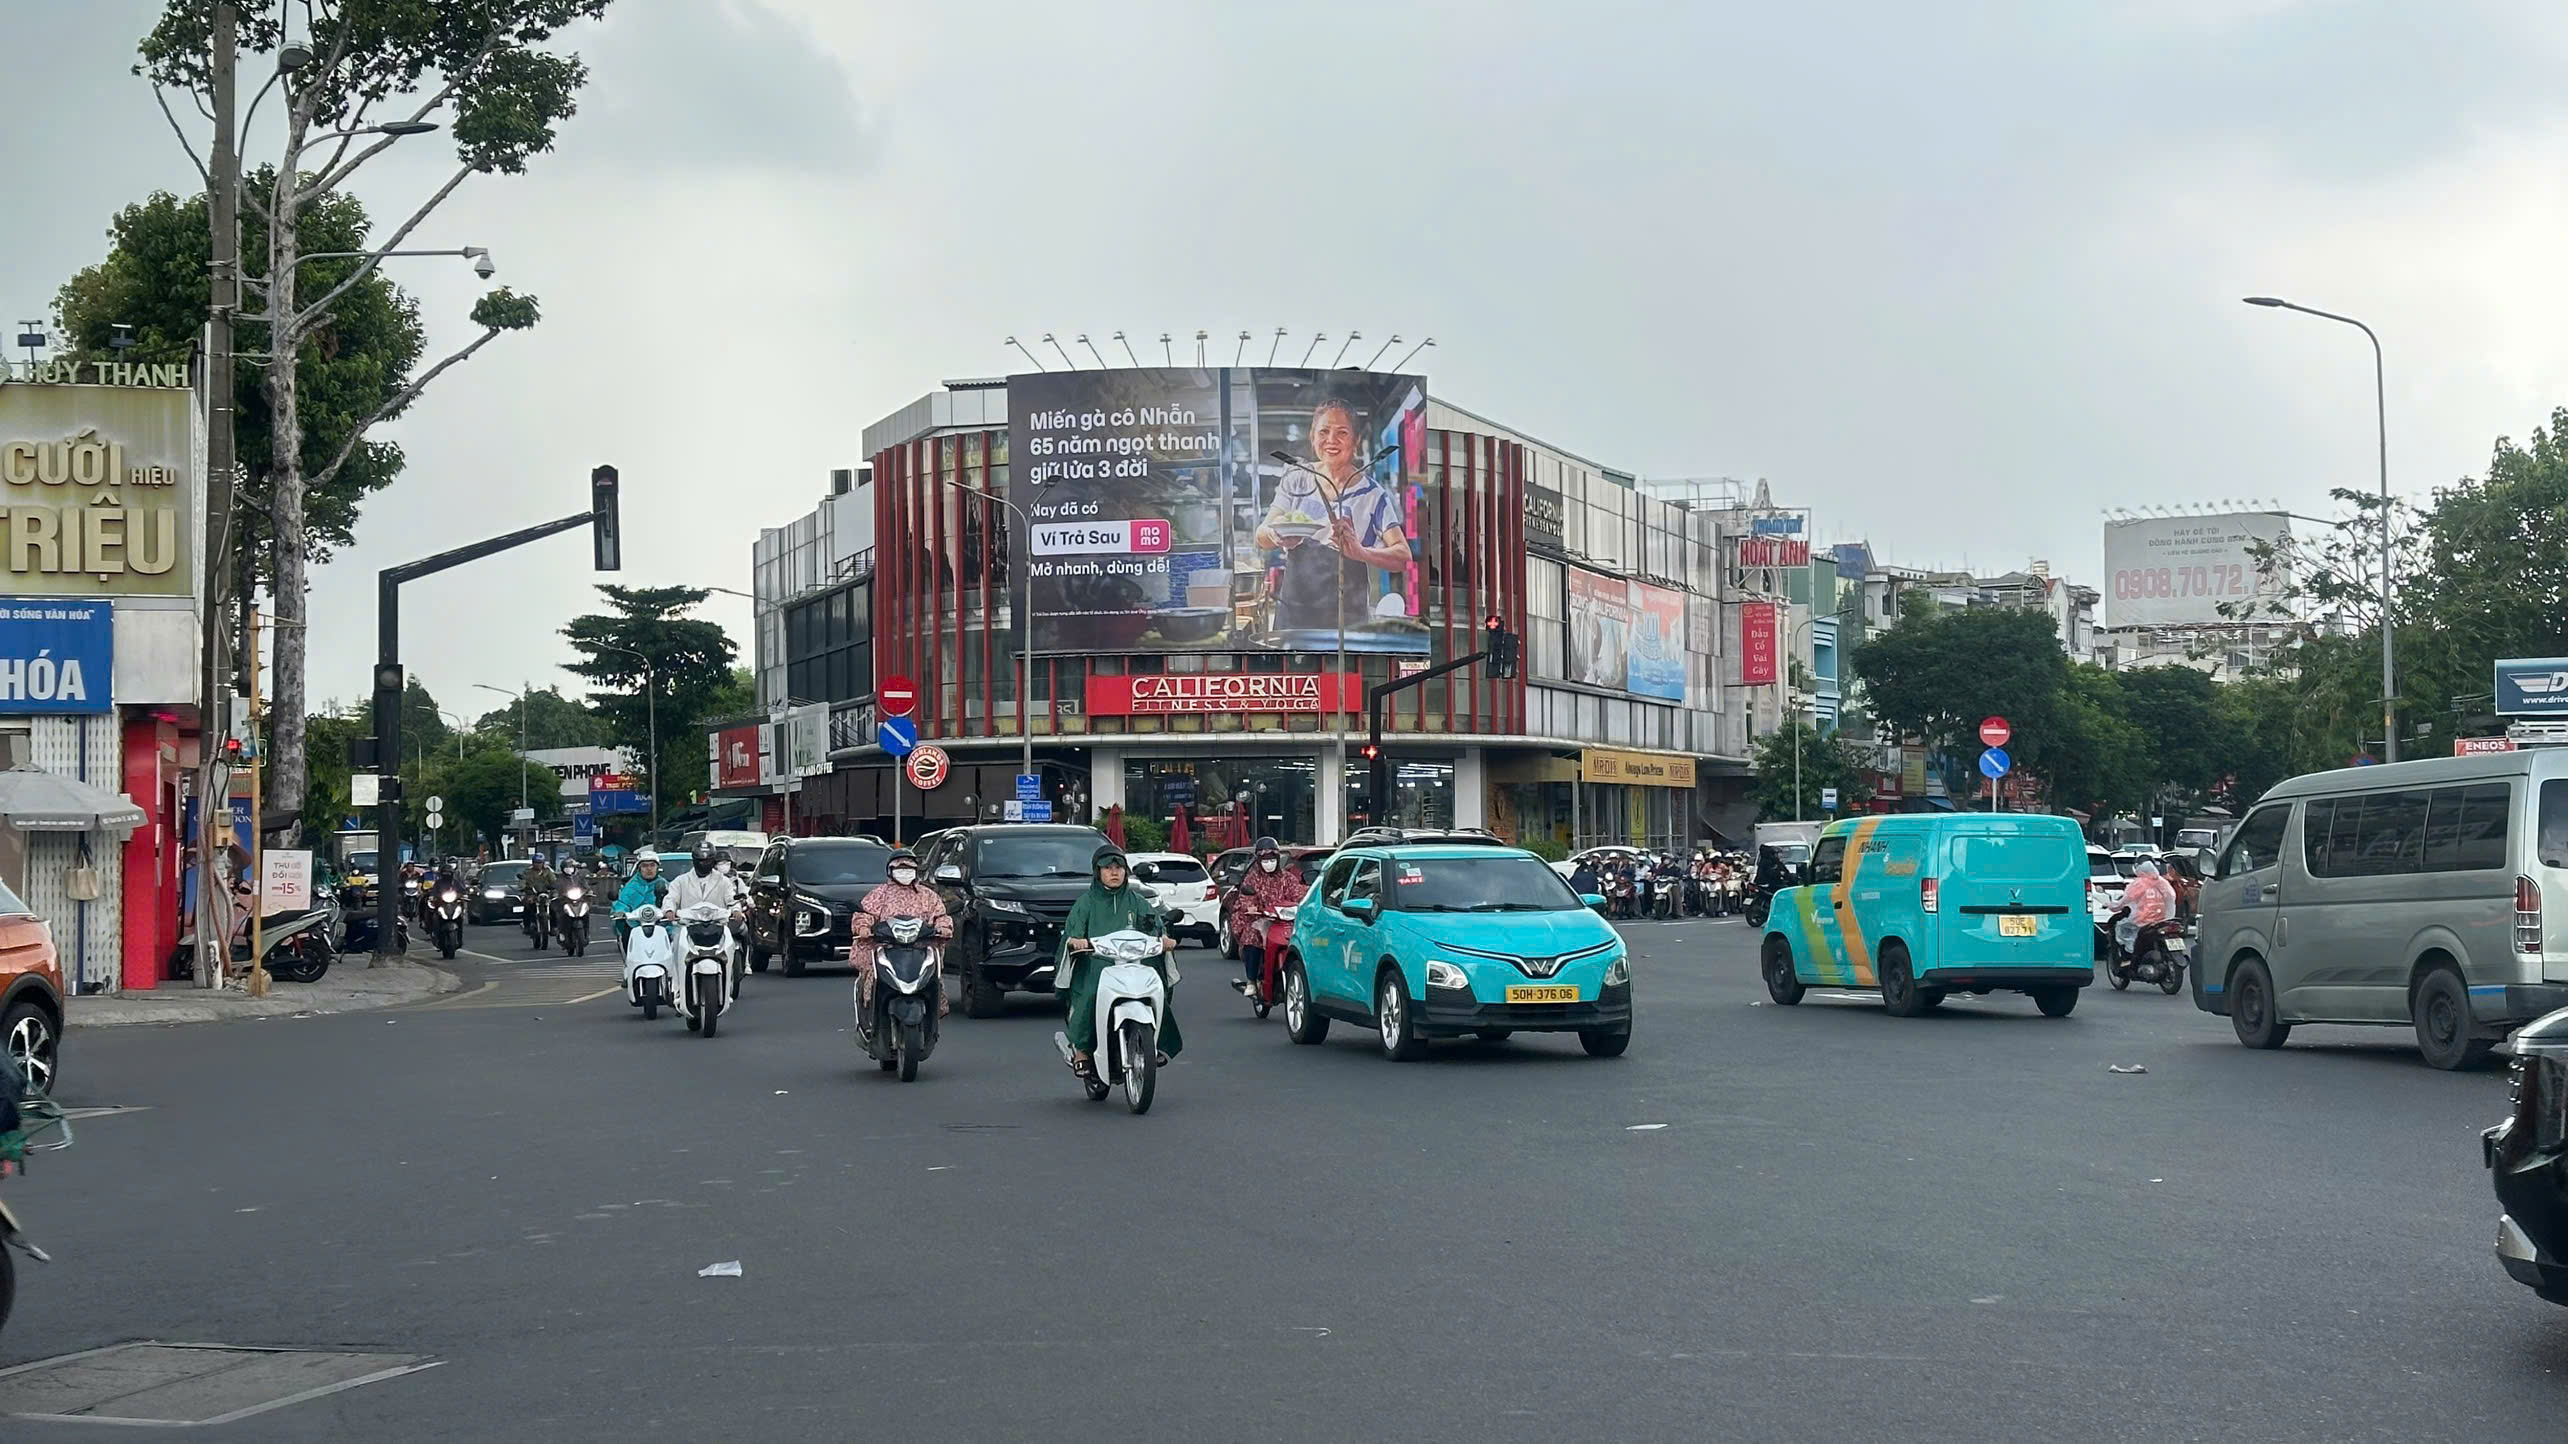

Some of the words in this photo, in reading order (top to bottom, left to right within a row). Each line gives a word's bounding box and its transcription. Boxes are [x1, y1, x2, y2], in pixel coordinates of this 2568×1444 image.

[23, 360, 81, 384] HUY
[92, 362, 188, 387] THANH
[1030, 408, 1076, 430] Miến
[1080, 409, 1105, 431] gà
[1110, 408, 1135, 427] cô
[1140, 403, 1195, 425] Nhẫn
[1030, 438, 1053, 455] 65
[1058, 435, 1101, 454] năm
[1106, 434, 1153, 456] ngọt
[1159, 432, 1219, 451] thanh
[3, 428, 122, 486] CƯỚI
[130, 466, 175, 490] HIỆU
[1063, 460, 1094, 479] lửa
[1098, 460, 1110, 478] 3
[1115, 458, 1148, 477] đời
[1031, 503, 1057, 518] Nay
[1060, 501, 1078, 516] đã
[1082, 501, 1098, 515] có
[0, 492, 175, 582] RIỆU
[1041, 531, 1056, 546] Ví
[1060, 529, 1084, 545] Trả
[1088, 531, 1121, 545] Sau
[1031, 561, 1052, 576] Mở
[1056, 561, 1103, 576] nhanh,
[1107, 560, 1143, 575] dùng
[1147, 557, 1170, 573] dễ!
[12, 606, 42, 619] SỐNG
[45, 608, 66, 620] VĂN
[0, 648, 86, 701] HÓA
[1132, 677, 1319, 698] CALIFORNIA
[1132, 699, 1228, 711] FITNESS
[1240, 699, 1249, 709] &
[1261, 698, 1319, 710] YOGA
[2465, 741, 2506, 751] ENEOS
[909, 748, 944, 767] HIGHLANDS
[913, 775, 941, 787] COFFEE
